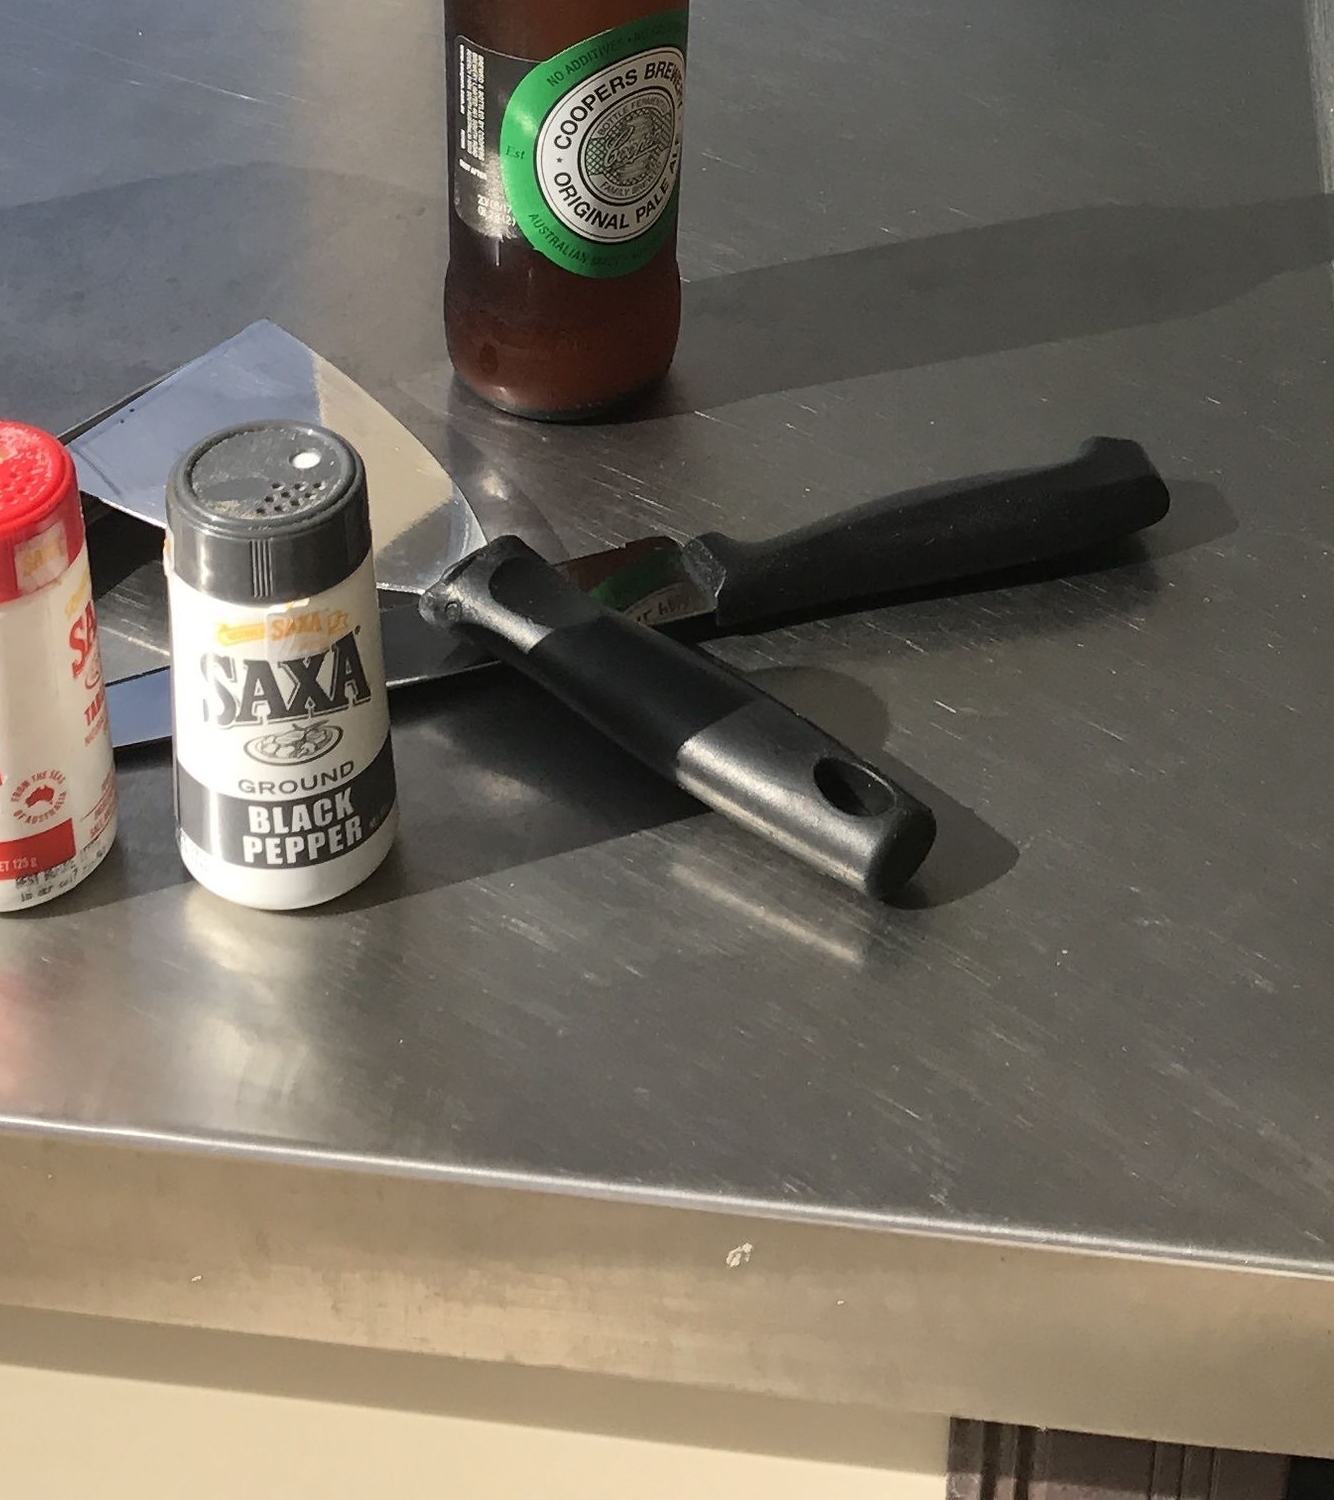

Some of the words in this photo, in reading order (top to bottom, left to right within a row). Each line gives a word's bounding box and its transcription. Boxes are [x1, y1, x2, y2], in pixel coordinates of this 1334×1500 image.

[546, 70, 565, 88] NO
[553, 68, 638, 150] COOPERS
[553, 171, 630, 230] ORIGINAL
[635, 177, 670, 223] PALE
[528, 213, 588, 264] AUSTRALIAN
[200, 630, 371, 730] SAXA
[238, 760, 355, 795] GROUND
[248, 787, 354, 835] BLACK
[242, 815, 363, 865] PEPPER
